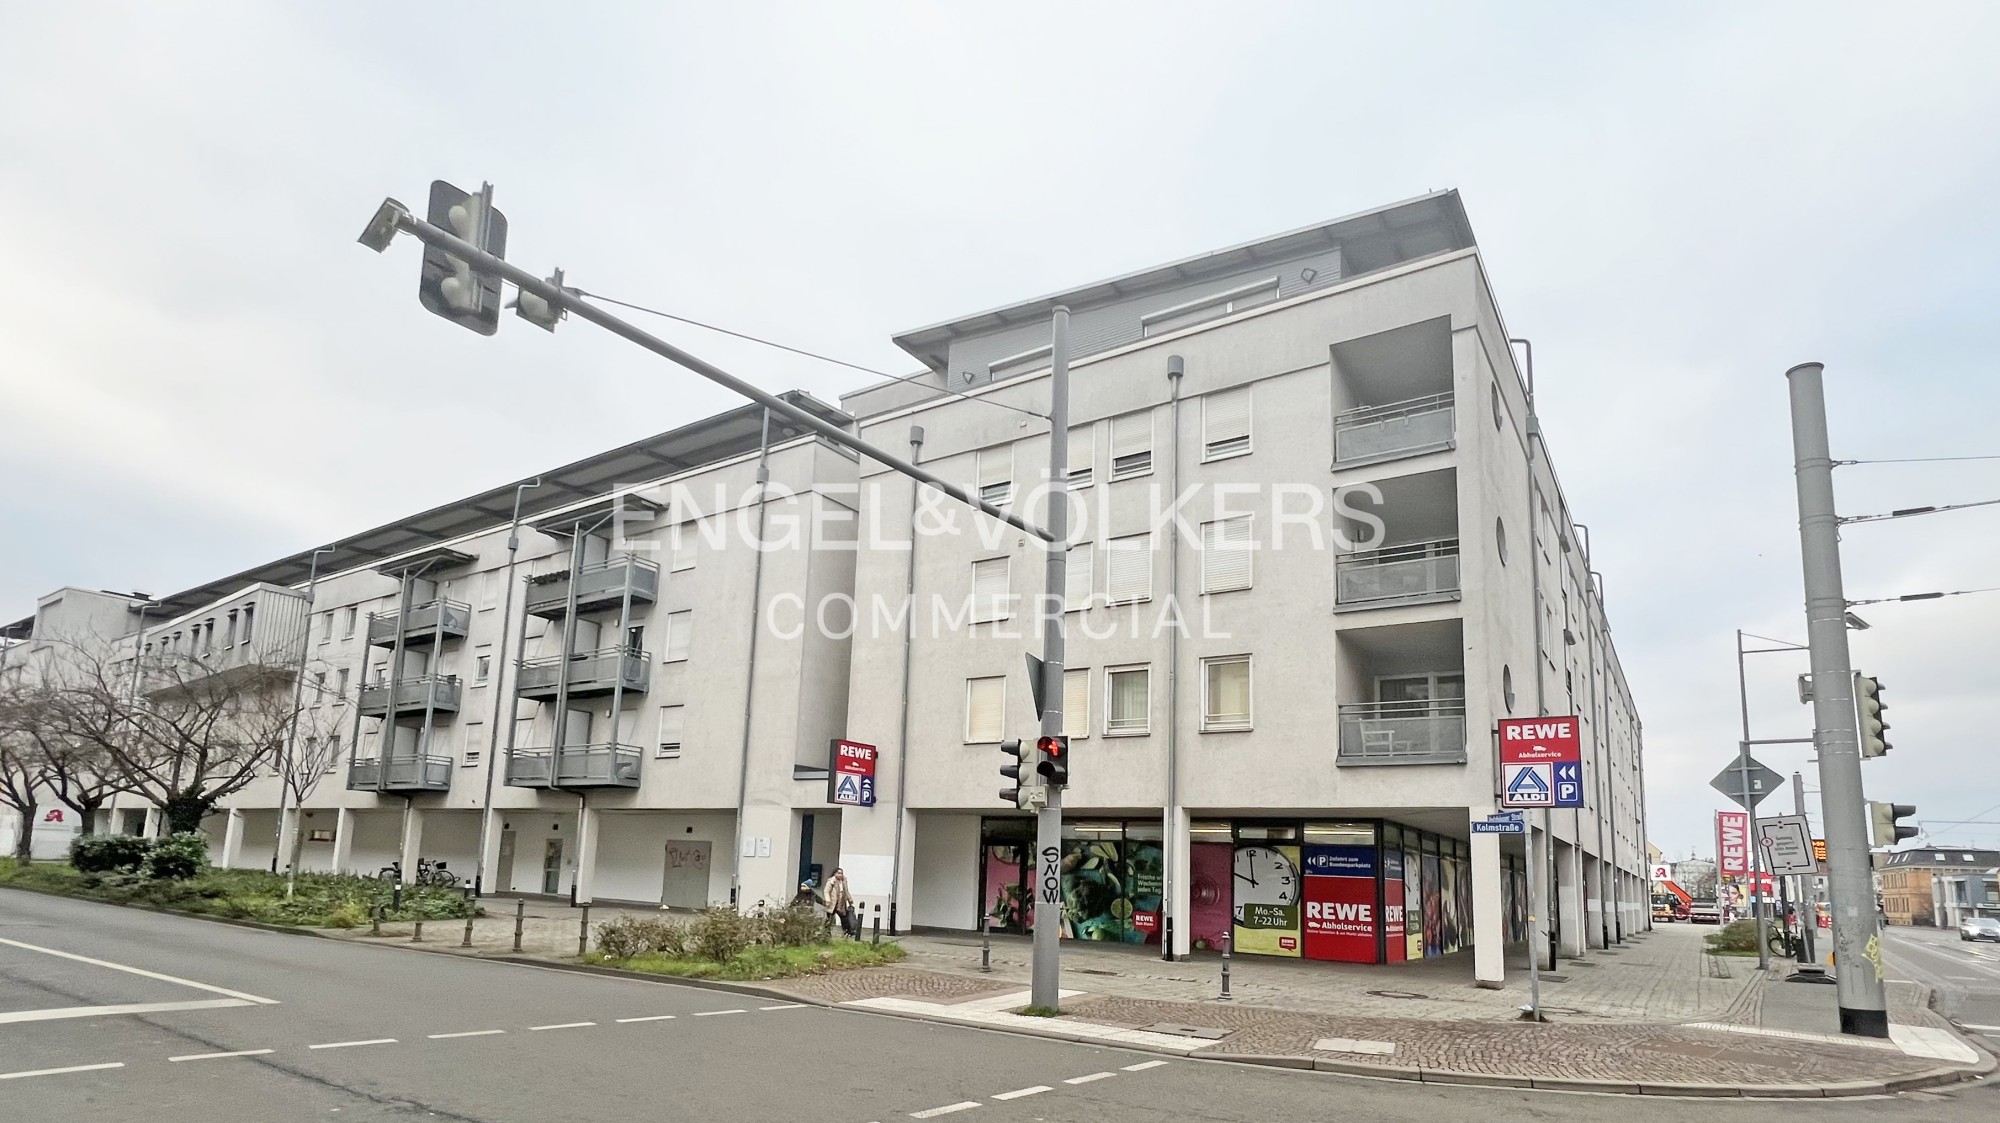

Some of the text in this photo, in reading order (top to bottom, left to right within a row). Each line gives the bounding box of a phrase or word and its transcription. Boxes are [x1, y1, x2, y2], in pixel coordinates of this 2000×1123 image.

[1506, 723, 1572, 740] REWE
[840, 744, 872, 760] REWE
[1518, 751, 1562, 759] Abholservice
[863, 791, 870, 801] P
[1561, 784, 1574, 799] P
[840, 793, 856, 801] ALDI
[1512, 793, 1546, 801] ALDI
[1476, 823, 1519, 832] Kolmstraße
[1722, 816, 1743, 871] REWE
[1319, 856, 1326, 866] P
[1274, 862, 1283, 870] 2
[1042, 846, 1059, 904] SNOW
[1281, 876, 1291, 885] 3
[1279, 891, 1288, 900] 4
[1235, 906, 1243, 915] 7
[1306, 901, 1372, 922] REWE
[1385, 905, 1403, 922] REWE
[1135, 914, 1154, 922] REWE
[1273, 917, 1288, 926] Uhr
[1322, 921, 1372, 932] Abholservice
